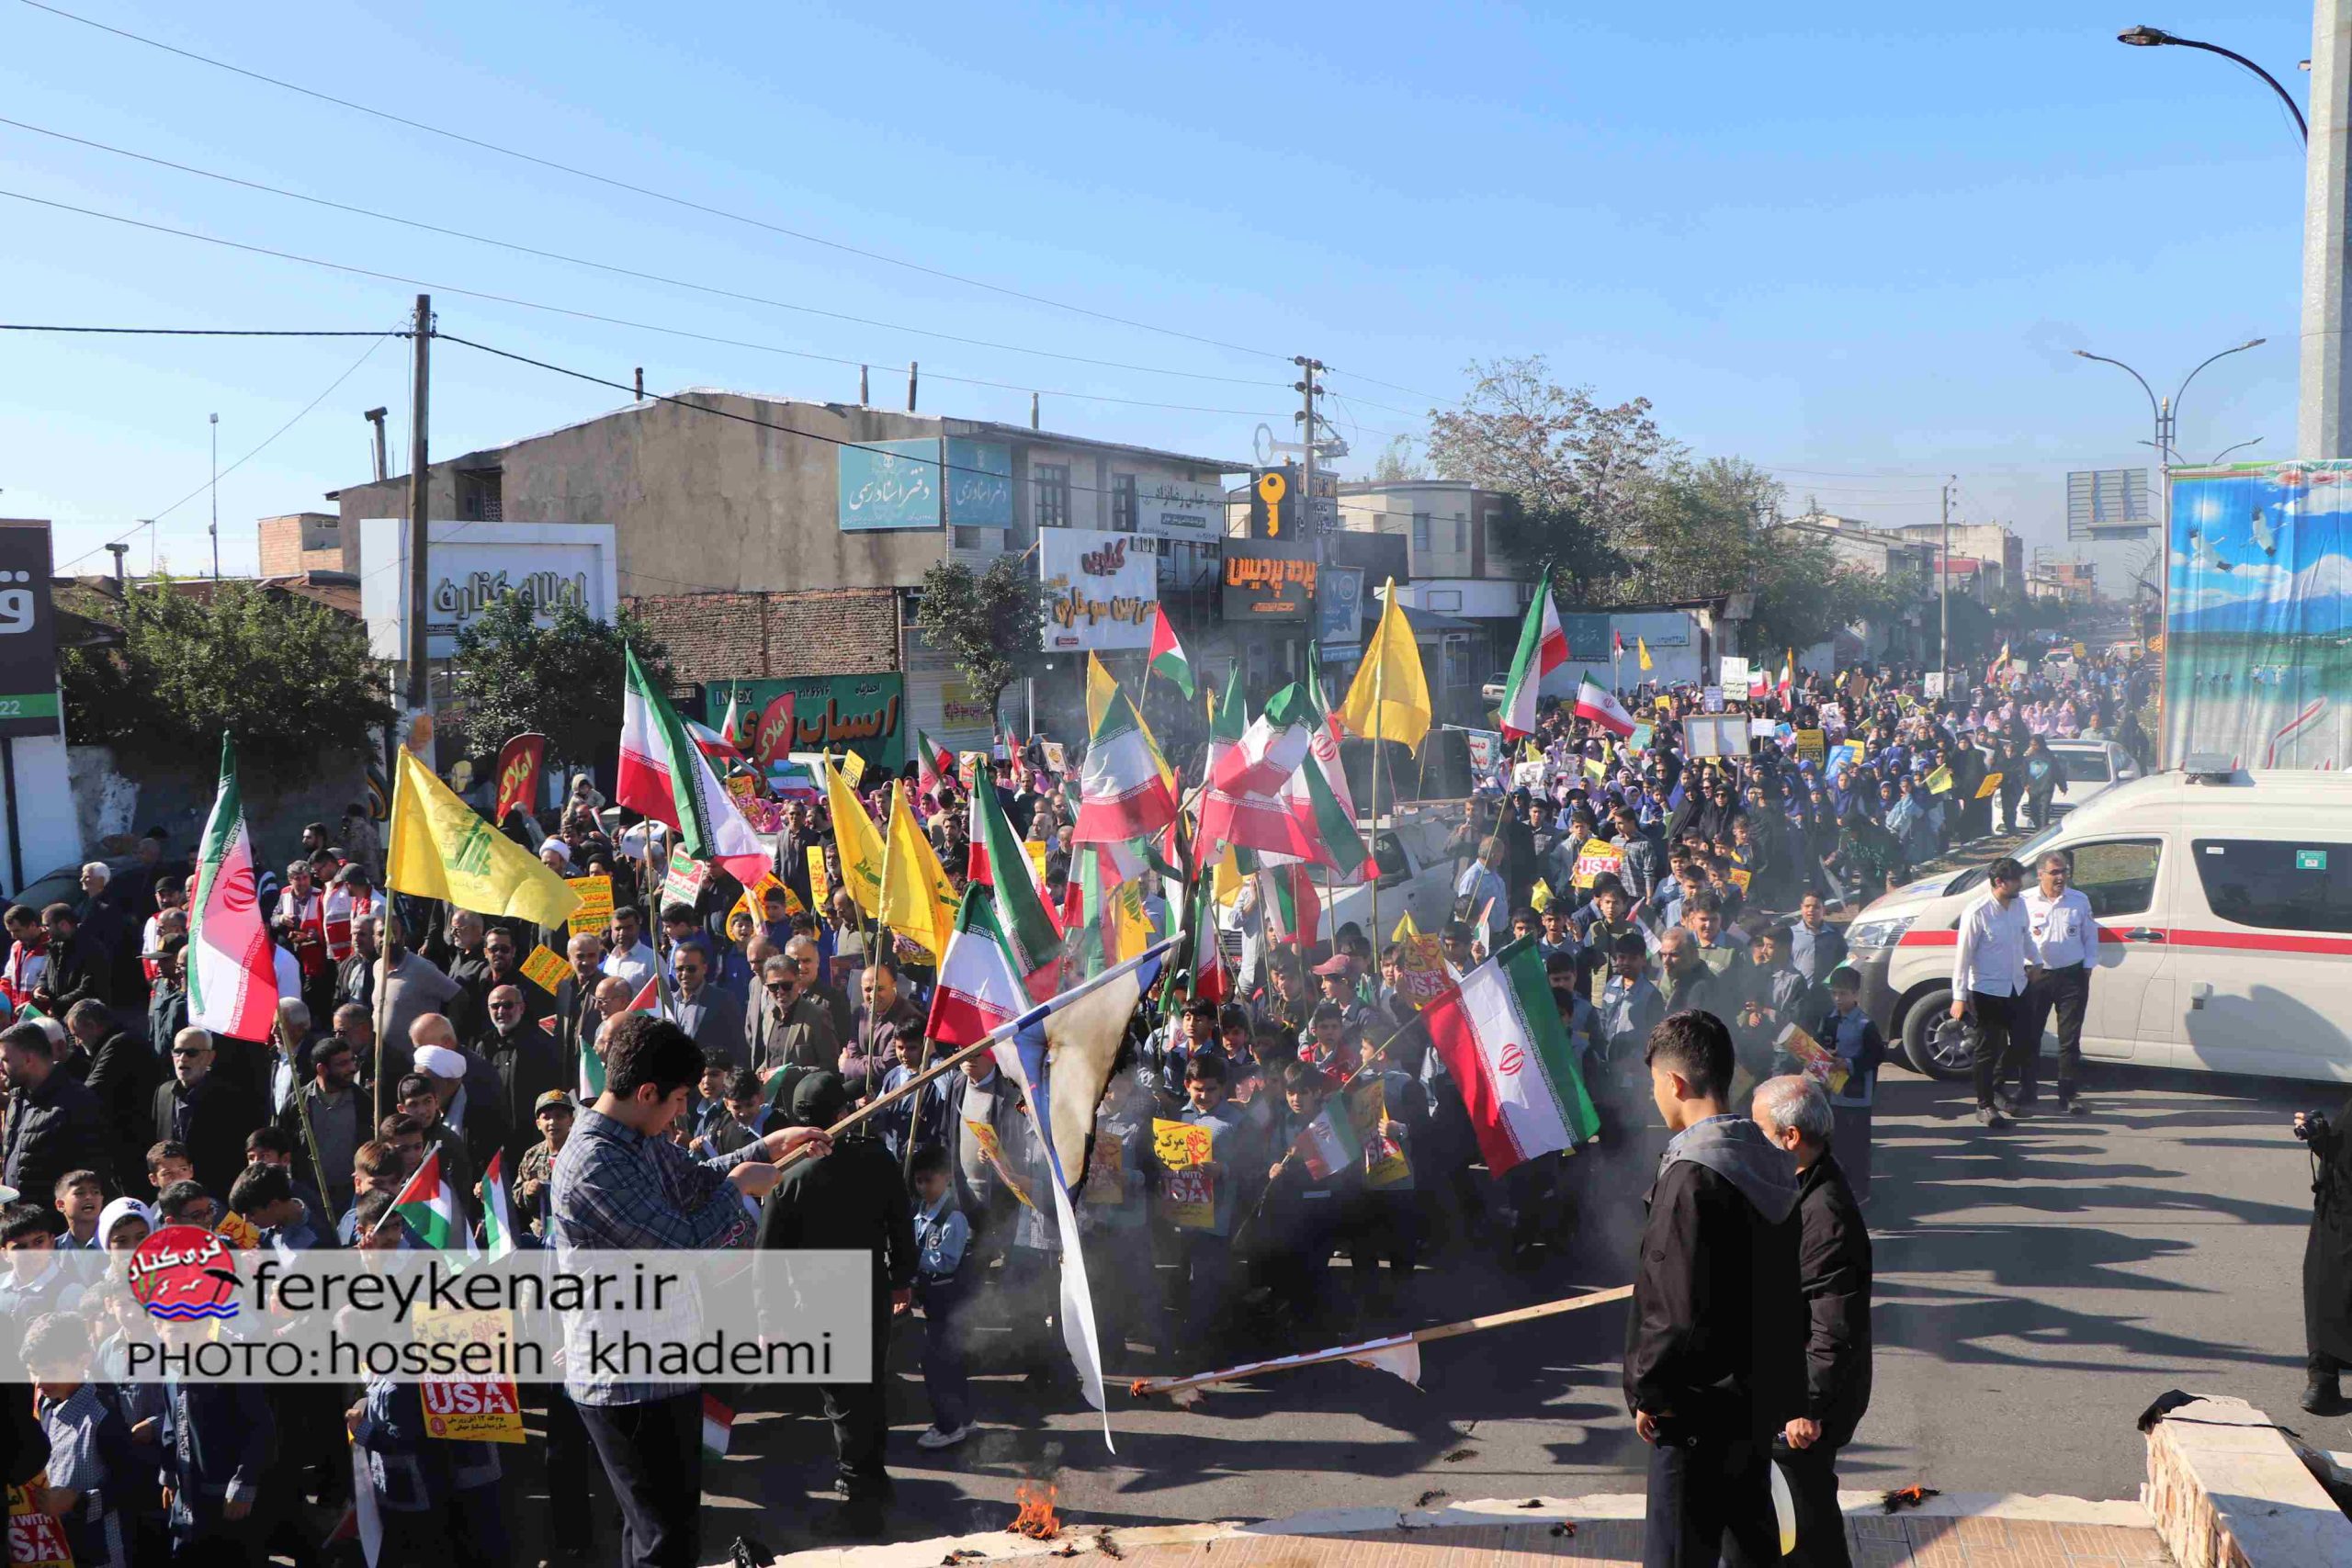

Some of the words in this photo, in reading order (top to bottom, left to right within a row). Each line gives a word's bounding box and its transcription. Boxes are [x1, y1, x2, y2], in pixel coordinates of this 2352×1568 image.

[849, 481, 874, 511] رسمی
[899, 468, 930, 507] دفتر
[1226, 557, 1285, 599] پردیس
[1285, 559, 1317, 599] پرده
[797, 694, 899, 752] اسباب
[1579, 858, 1616, 875] USA
[1161, 1134, 1185, 1151] مرگ
[425, 1383, 514, 1414] USA
[17, 1513, 53, 1527] WITH
[8, 1525, 66, 1562] SA
